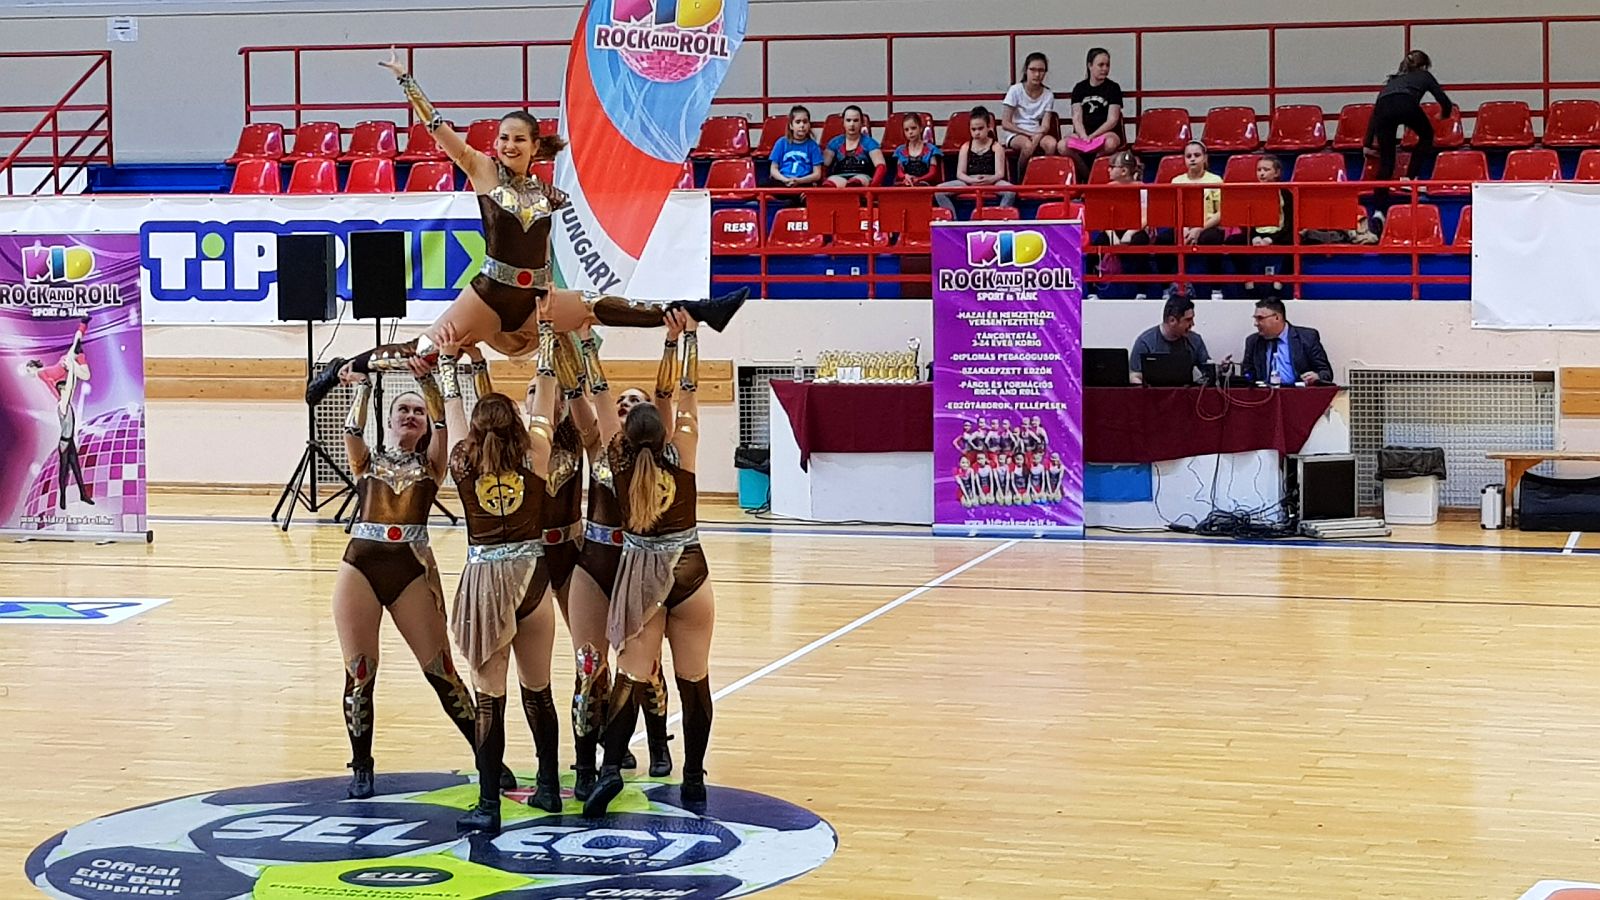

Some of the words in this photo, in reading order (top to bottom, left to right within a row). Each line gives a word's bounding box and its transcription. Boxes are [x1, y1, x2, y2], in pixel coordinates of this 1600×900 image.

[966, 230, 1047, 267] KID
[22, 245, 96, 283] KID
[976, 292, 1005, 301] SPORT
[973, 388, 998, 396] ROCK
[1000, 388, 1018, 396] AND
[1020, 388, 1041, 396] ROLL
[91, 859, 181, 876] Official
[75, 867, 126, 881] EHF
[127, 875, 181, 887] Ball
